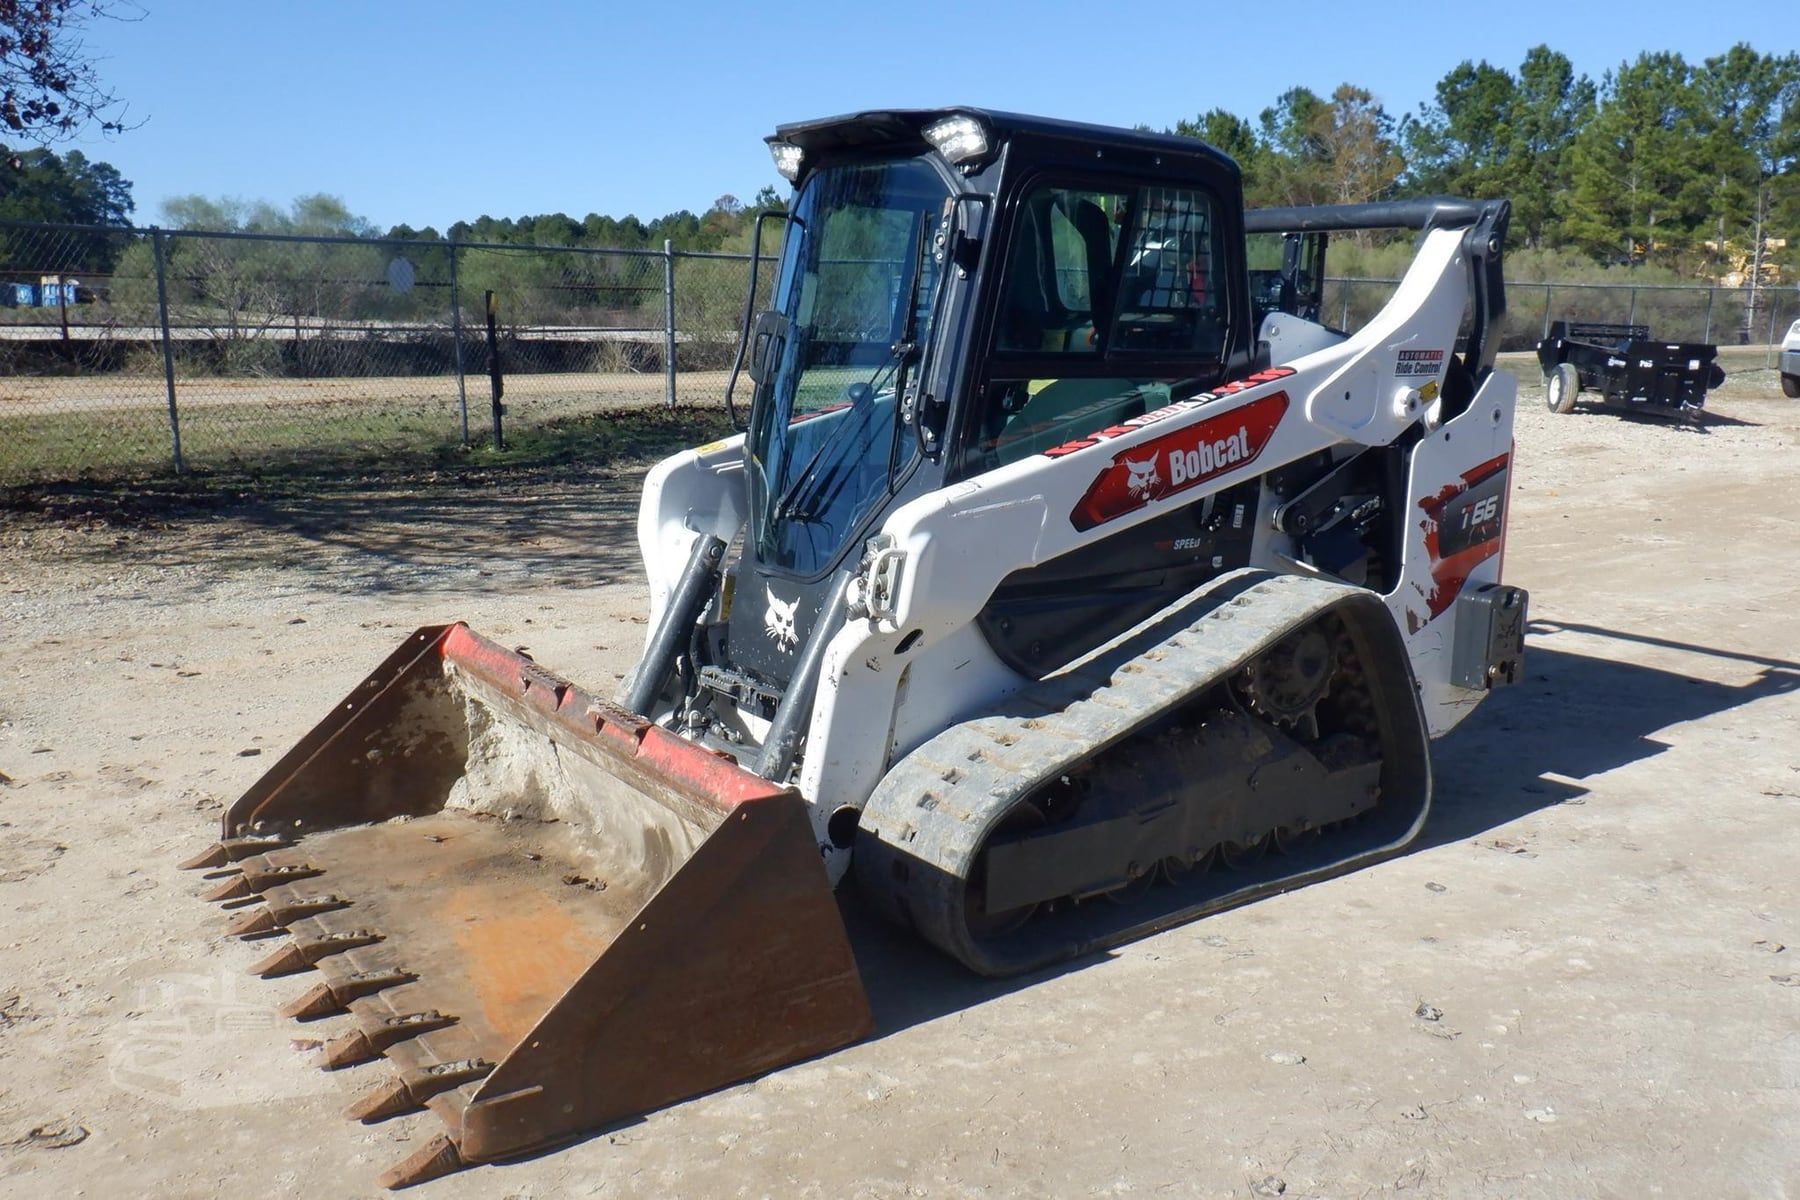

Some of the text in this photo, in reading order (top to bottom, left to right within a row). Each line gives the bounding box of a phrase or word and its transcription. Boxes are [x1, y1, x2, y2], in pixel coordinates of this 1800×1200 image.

[1396, 361, 1443, 374] Ride Control
[1169, 425, 1249, 486] Bobcat
